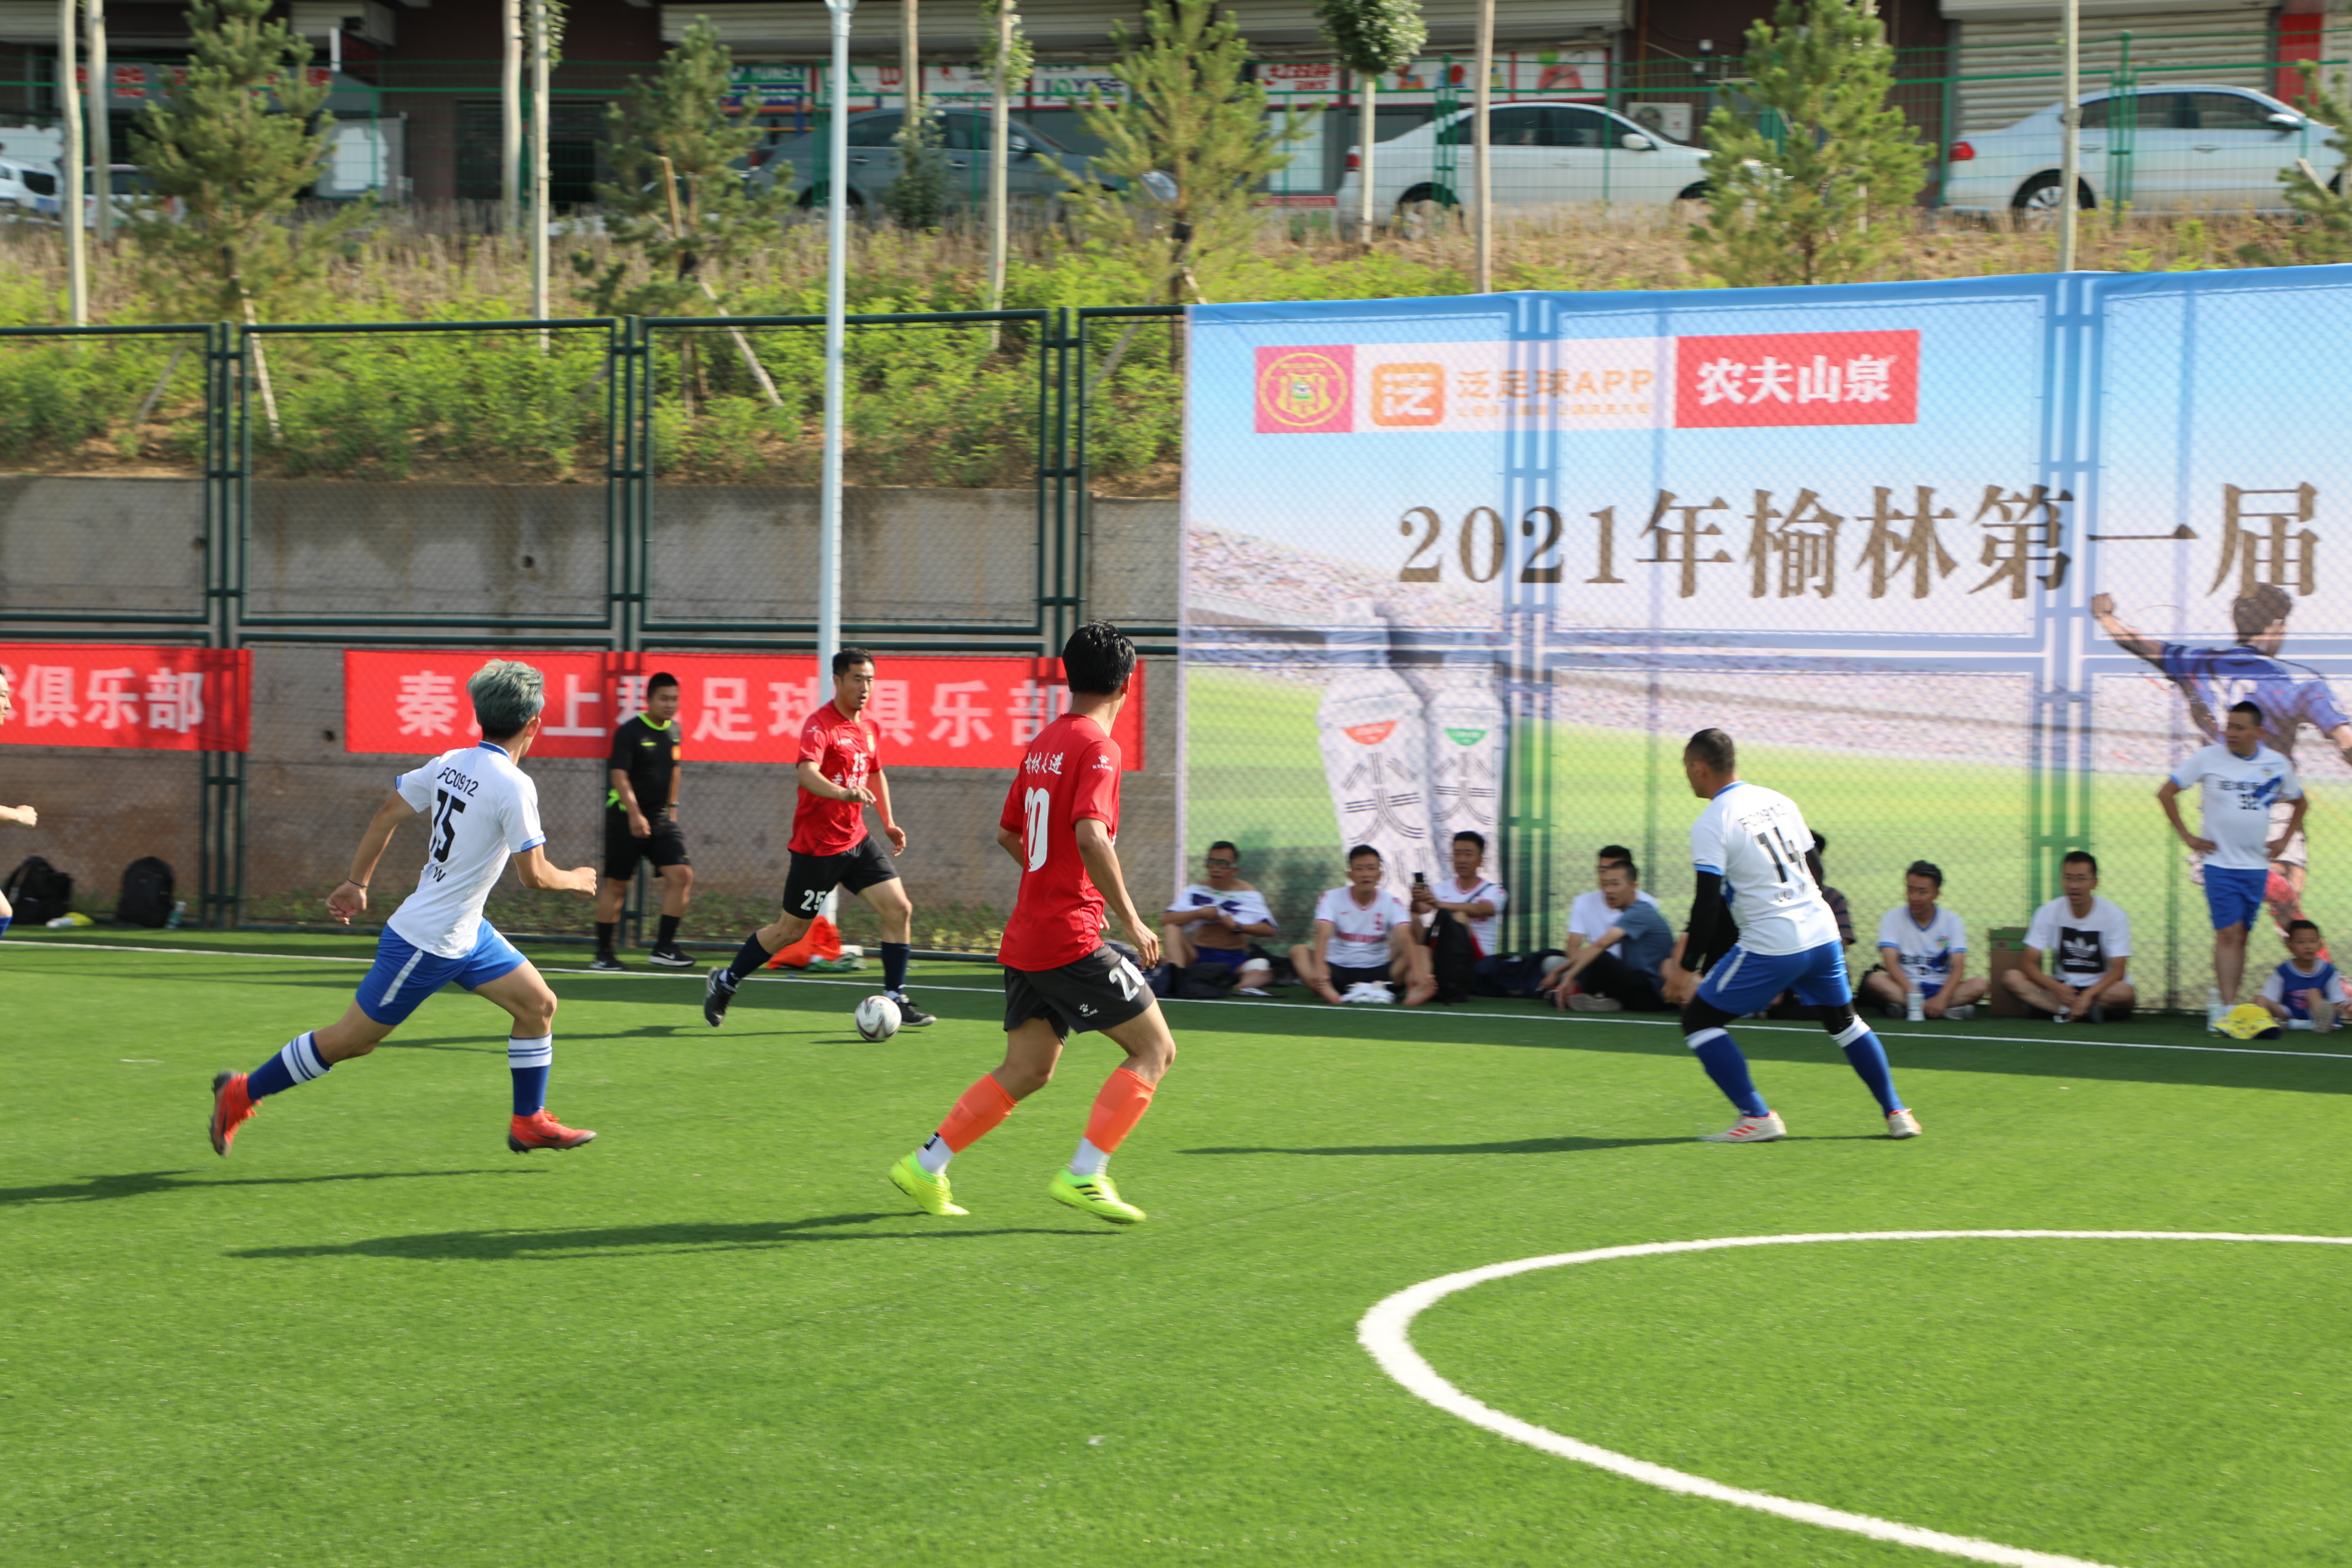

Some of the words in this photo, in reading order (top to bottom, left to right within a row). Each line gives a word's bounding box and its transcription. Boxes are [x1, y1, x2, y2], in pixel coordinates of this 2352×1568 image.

[1457, 368, 1654, 398] 泛足球APP
[1696, 354, 1893, 406] 农夫山泉
[1398, 482, 2319, 600] 2021年榆林第一届
[0, 664, 206, 733] 俱乐部
[852, 752, 868, 772] 25
[436, 767, 479, 797] FC0912
[800, 889, 827, 912] 25
[1109, 956, 1145, 1002] 20
